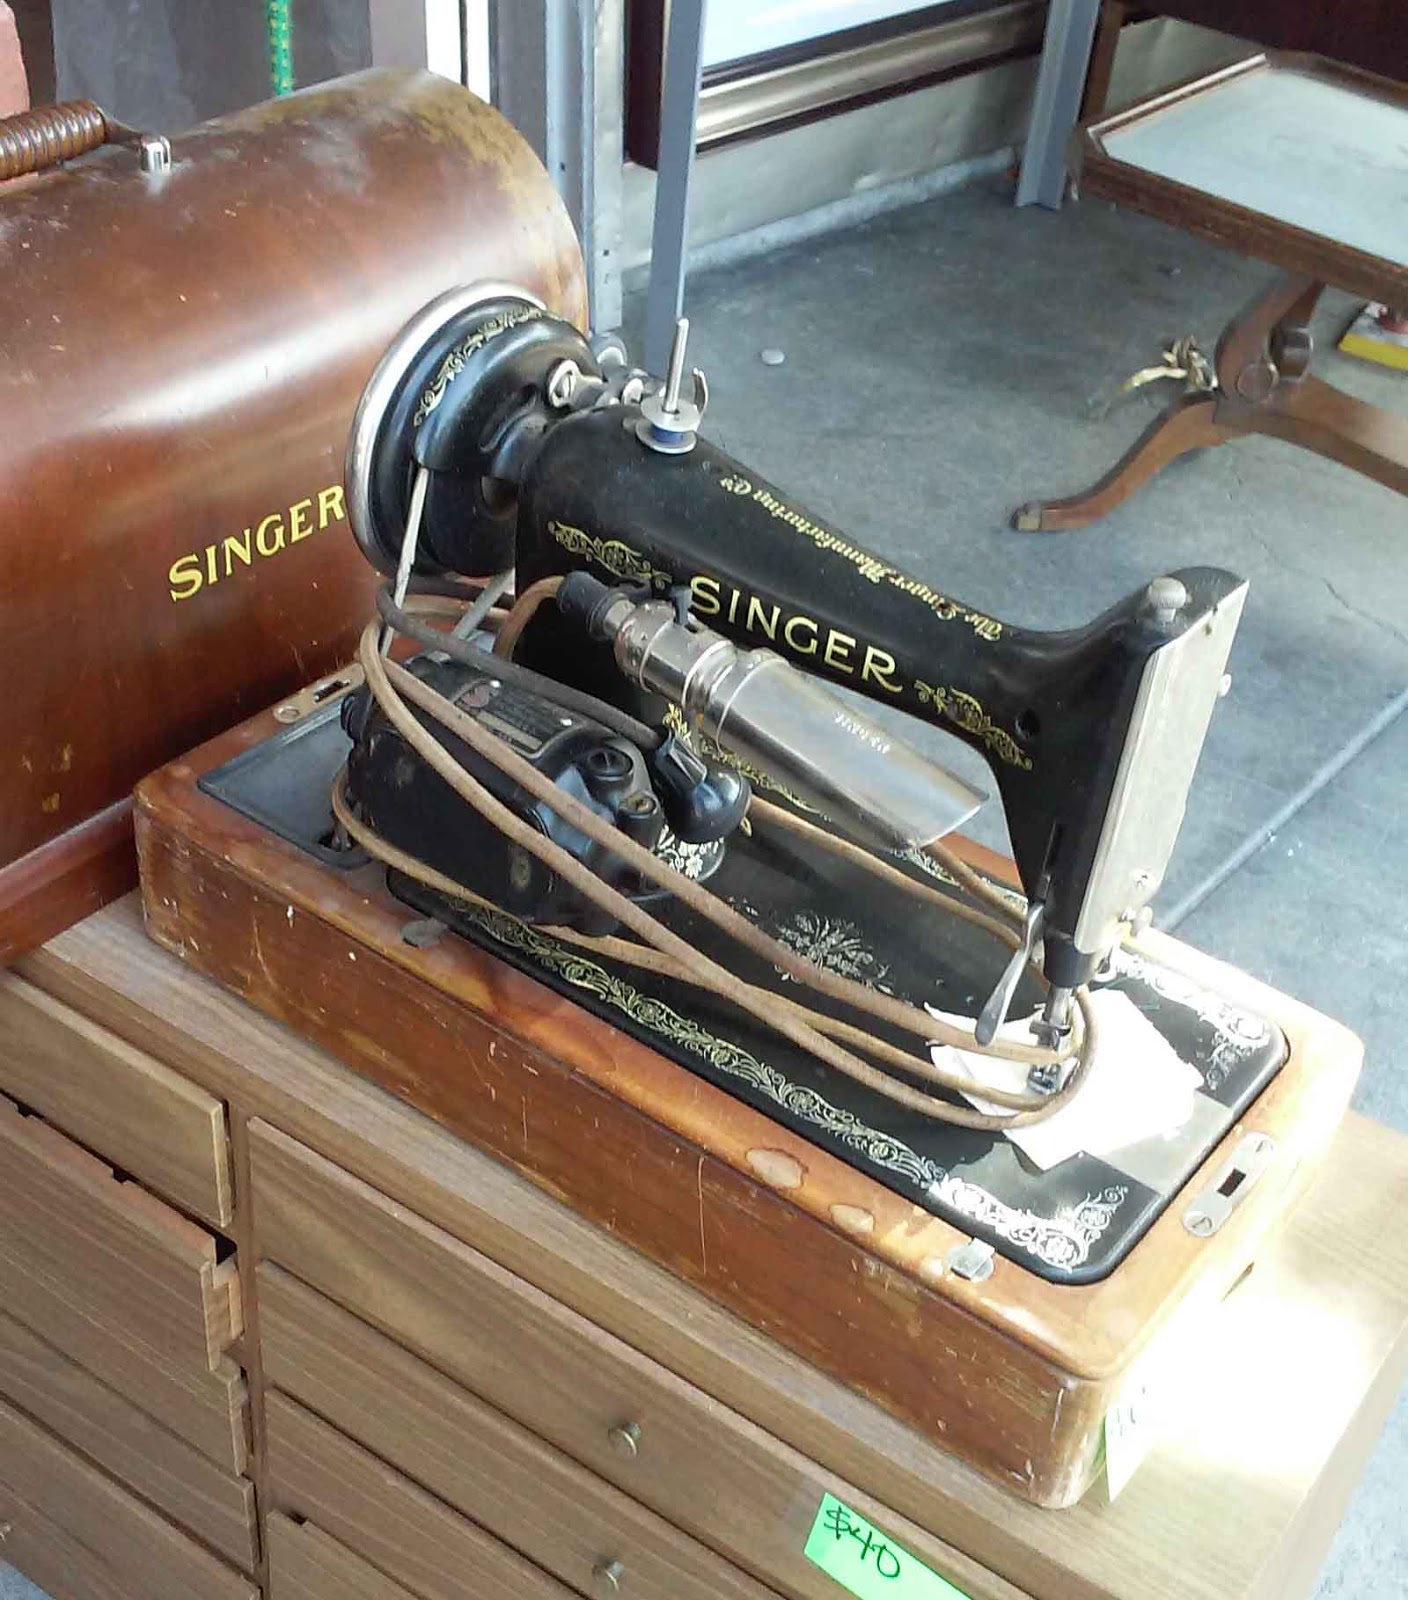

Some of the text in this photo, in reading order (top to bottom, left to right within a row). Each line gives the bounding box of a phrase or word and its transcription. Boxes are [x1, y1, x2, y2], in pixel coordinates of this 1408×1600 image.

[168, 484, 346, 602] SINGER
[690, 575, 903, 693] SINGER
[823, 1505, 900, 1579] $40
